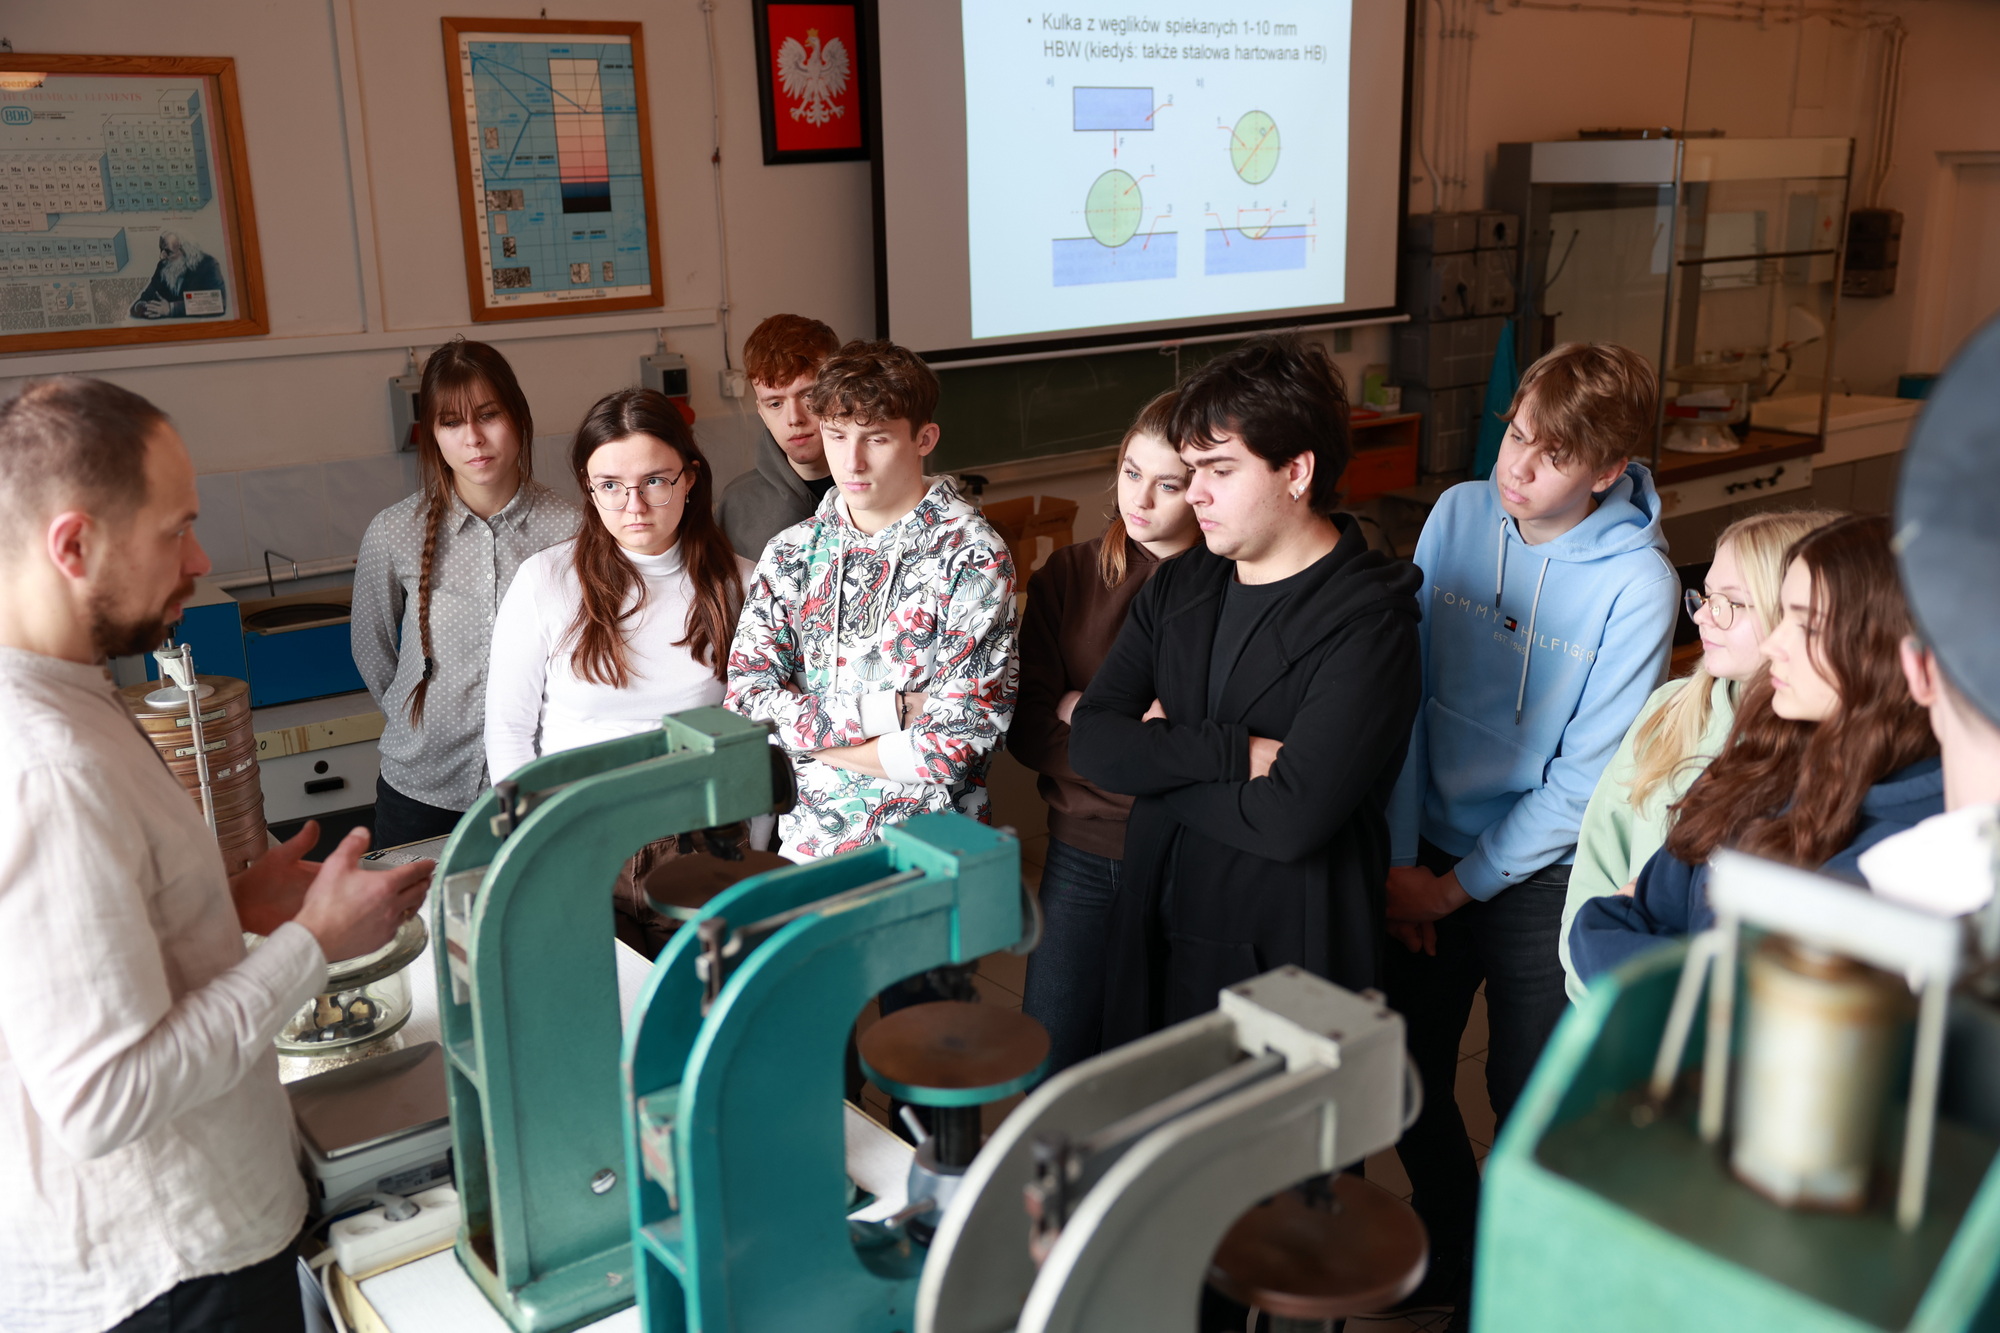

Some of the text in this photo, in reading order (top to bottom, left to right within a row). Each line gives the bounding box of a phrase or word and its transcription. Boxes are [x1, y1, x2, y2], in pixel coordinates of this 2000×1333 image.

[1042, 12, 1298, 38] Kulka z węglików spiekanych 1-10 mm
[1043, 40, 1327, 64] HBW (kiedyś: także stalowa hartowana HB)
[22, 92, 80, 101] CHEMICAL
[84, 92, 142, 101] ELEMENTS
[5, 110, 29, 121] BDH
[1433, 585, 1596, 663] TOMMY HILFIGER
